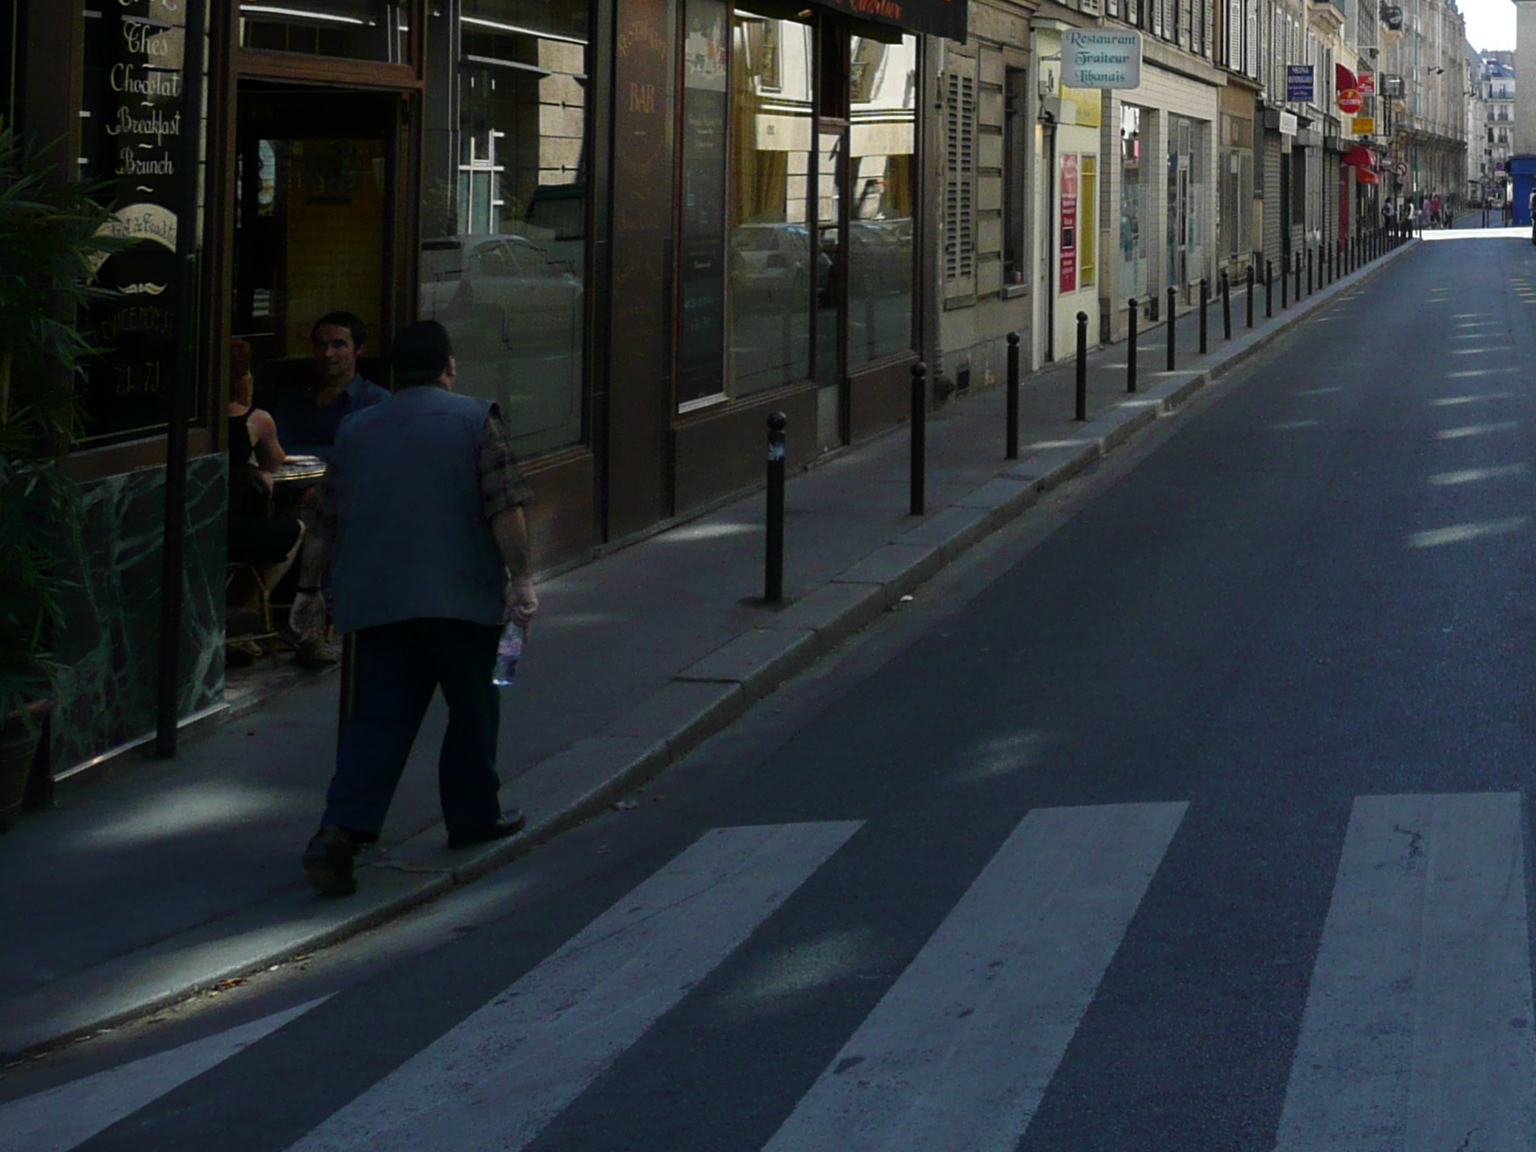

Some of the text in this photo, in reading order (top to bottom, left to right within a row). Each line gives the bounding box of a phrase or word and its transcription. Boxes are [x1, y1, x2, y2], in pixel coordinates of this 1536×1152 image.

[1065, 31, 1136, 49] Restaurant
[1074, 51, 1130, 66] Traiteur
[1074, 69, 1126, 86] Libanais
[629, 82, 655, 114] BAR
[105, 105, 181, 147] Breakfast
[115, 145, 175, 176] Brunch
